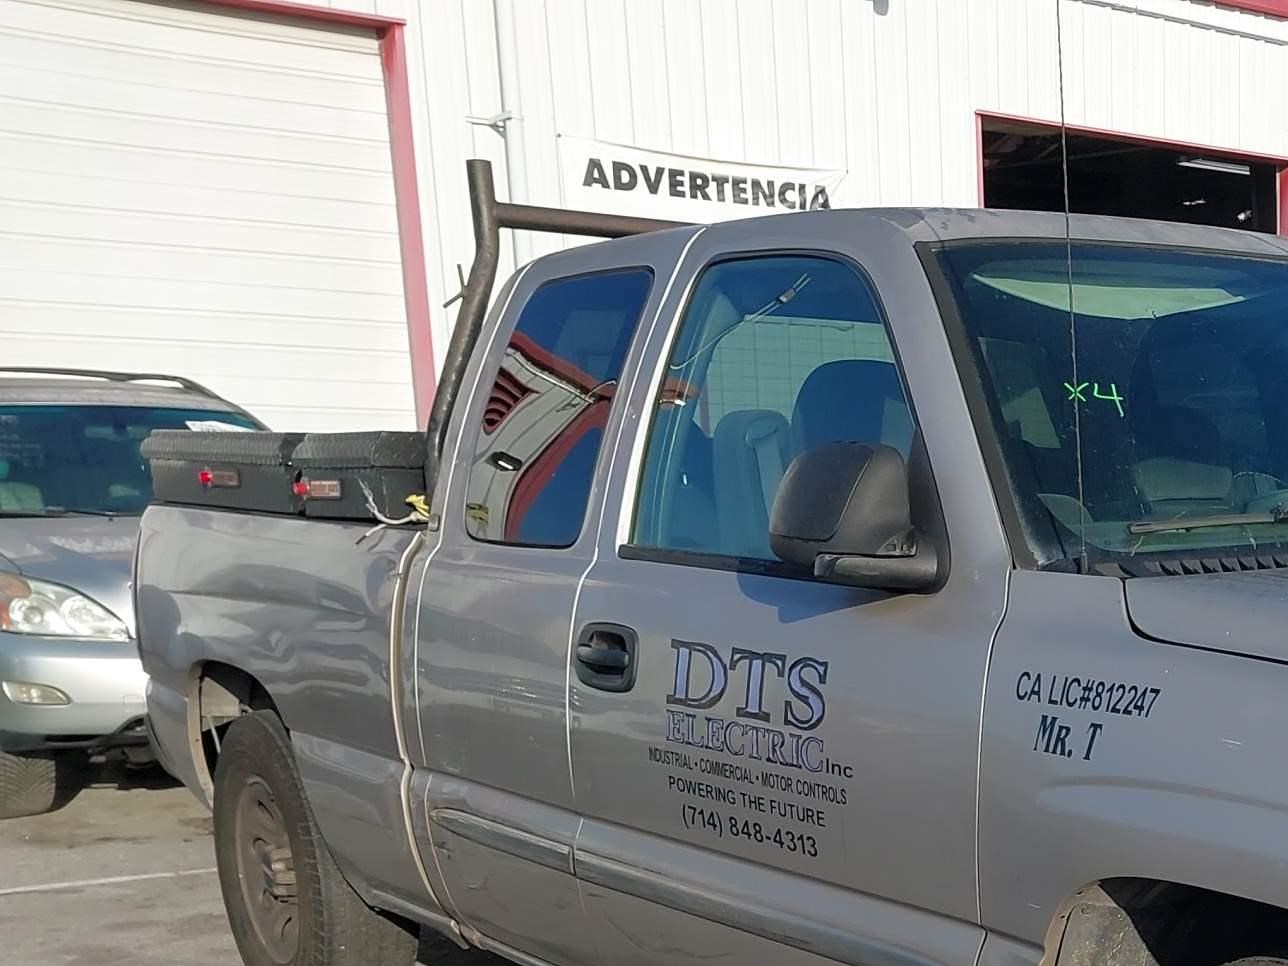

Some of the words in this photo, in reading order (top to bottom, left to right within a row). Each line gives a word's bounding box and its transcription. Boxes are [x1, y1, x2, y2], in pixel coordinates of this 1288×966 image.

[582, 158, 832, 211] ADVERTENCIA
[666, 638, 829, 731] DTS
[1016, 671, 1042, 703] CA
[1048, 675, 1161, 718] LIC#812247
[666, 709, 824, 773] ELECTRIC
[825, 757, 853, 779] Inc
[1083, 722, 1104, 761] T
[649, 746, 693, 771] INDUSTRIAL
[700, 759, 754, 784] COMMERCIAL
[761, 771, 793, 793] MOTOR
[796, 780, 847, 806] CONTROLS
[668, 776, 736, 806] POWERING
[739, 791, 766, 813] THE
[770, 799, 826, 828] FUTURE
[682, 803, 723, 838] (714)
[729, 816, 818, 857] 848-4313
